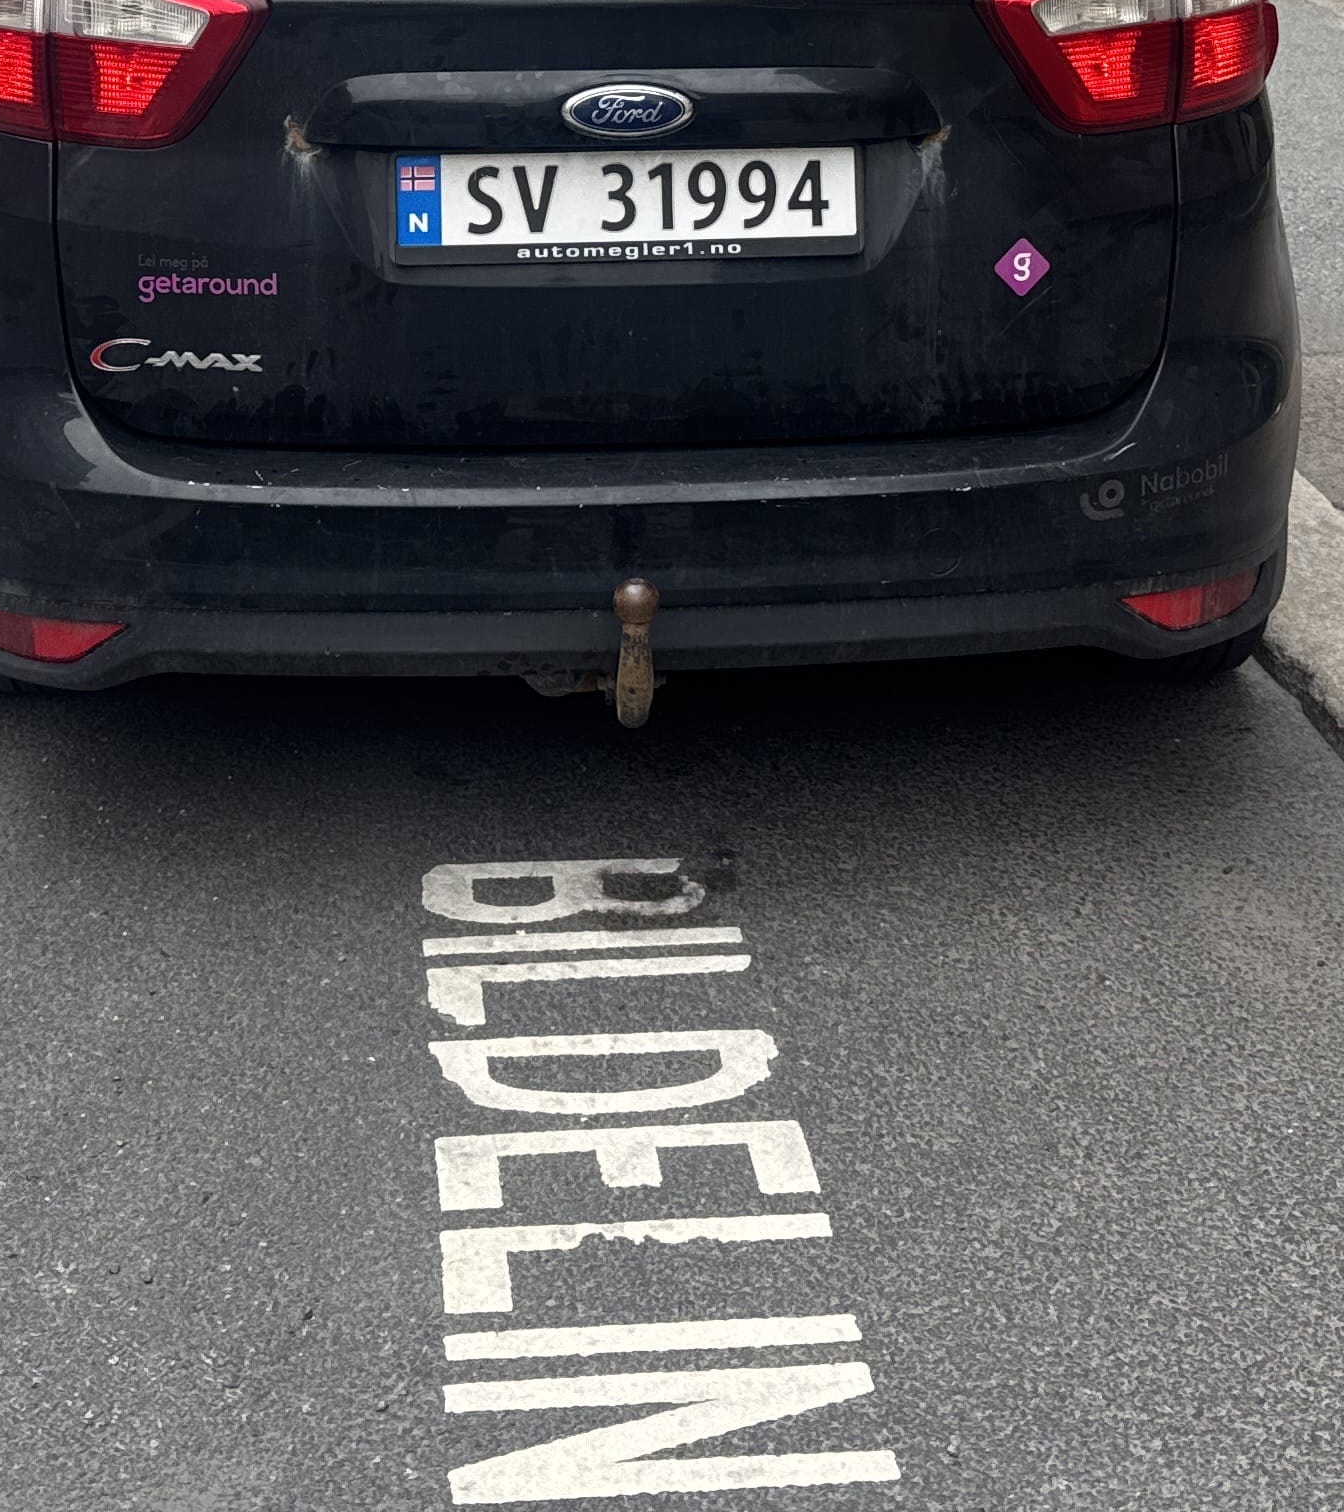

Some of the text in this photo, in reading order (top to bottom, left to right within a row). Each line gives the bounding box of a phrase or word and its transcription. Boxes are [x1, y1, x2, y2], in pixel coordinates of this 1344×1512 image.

[591, 94, 664, 125] Ford
[467, 160, 829, 235] SV 31994
[409, 213, 428, 233] N
[159, 258, 188, 271] meg
[517, 242, 742, 260] automegler1.no
[138, 273, 278, 303] getaround
[1140, 452, 1229, 497] Nabobil
[422, 857, 902, 1505] BILDELIN
